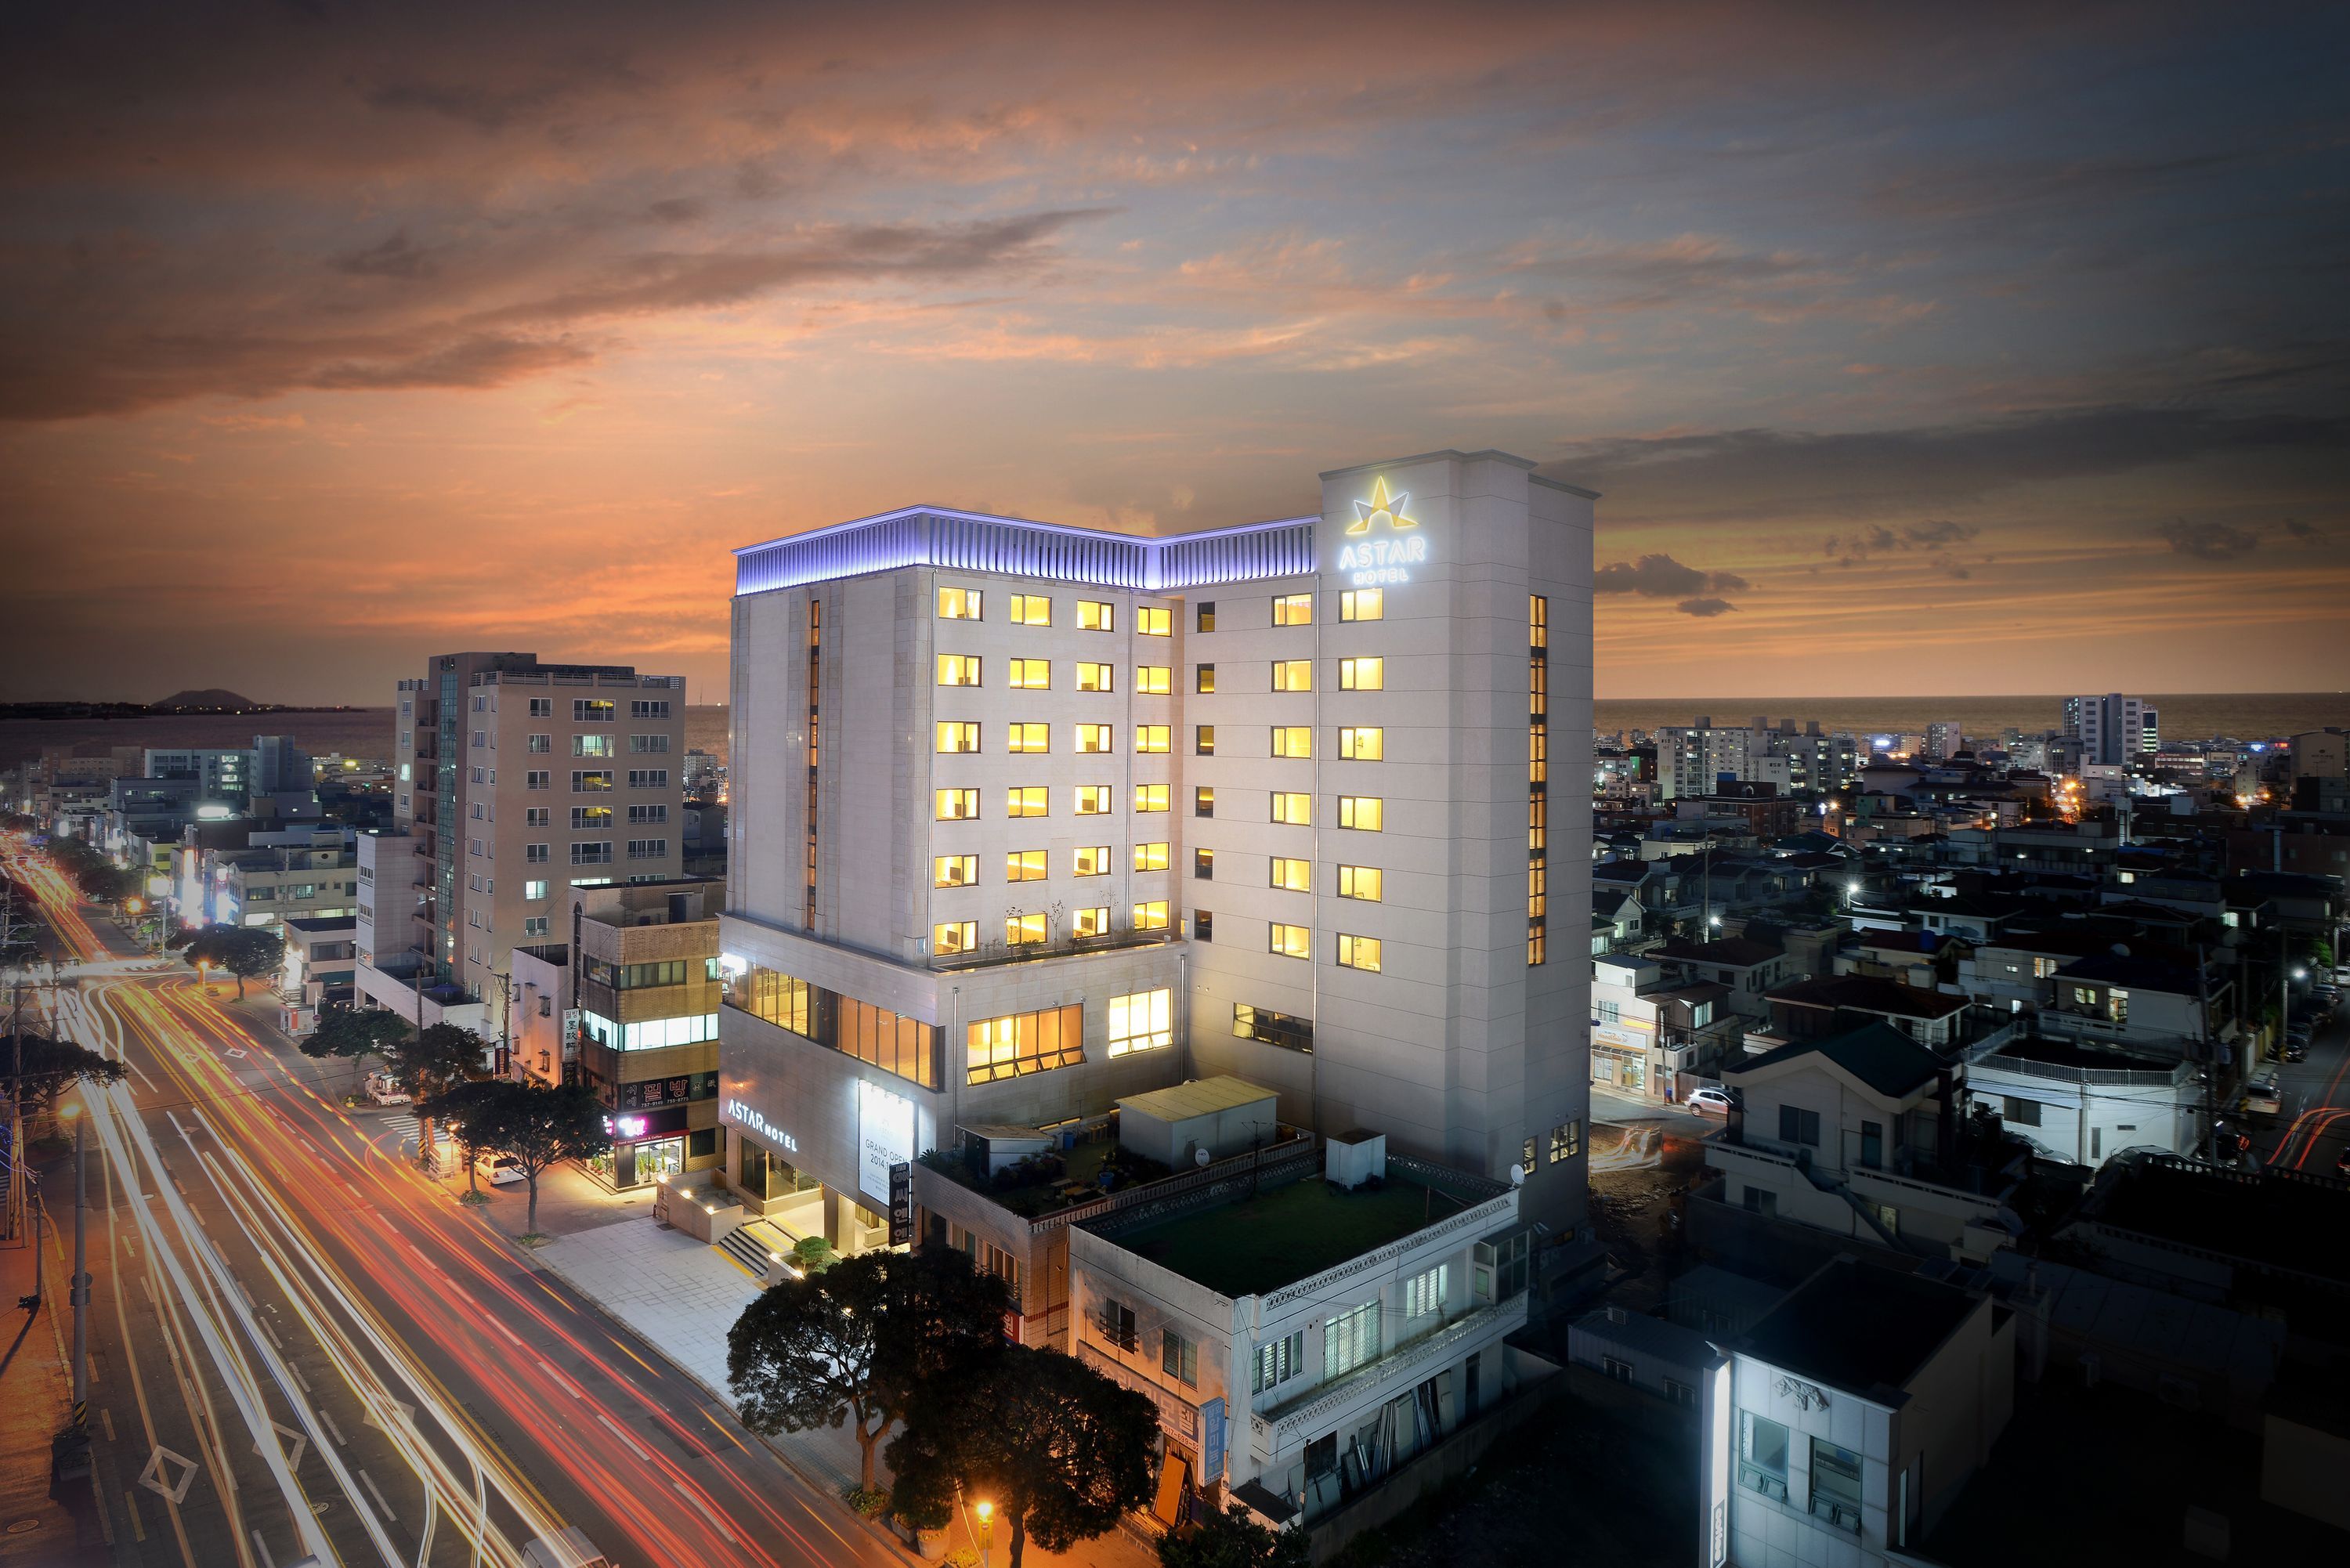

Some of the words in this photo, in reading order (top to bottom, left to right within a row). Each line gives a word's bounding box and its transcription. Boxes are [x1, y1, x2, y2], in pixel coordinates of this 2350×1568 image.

[1340, 537, 1425, 570] ASTAR
[1354, 569, 1408, 585] HOTEL
[644, 1079, 688, 1103] 필방
[728, 1098, 765, 1133] ASTAR
[765, 1123, 797, 1152] HOTEL
[866, 1139, 888, 1158] GRAND
[870, 1154, 891, 1172] 2014.1
